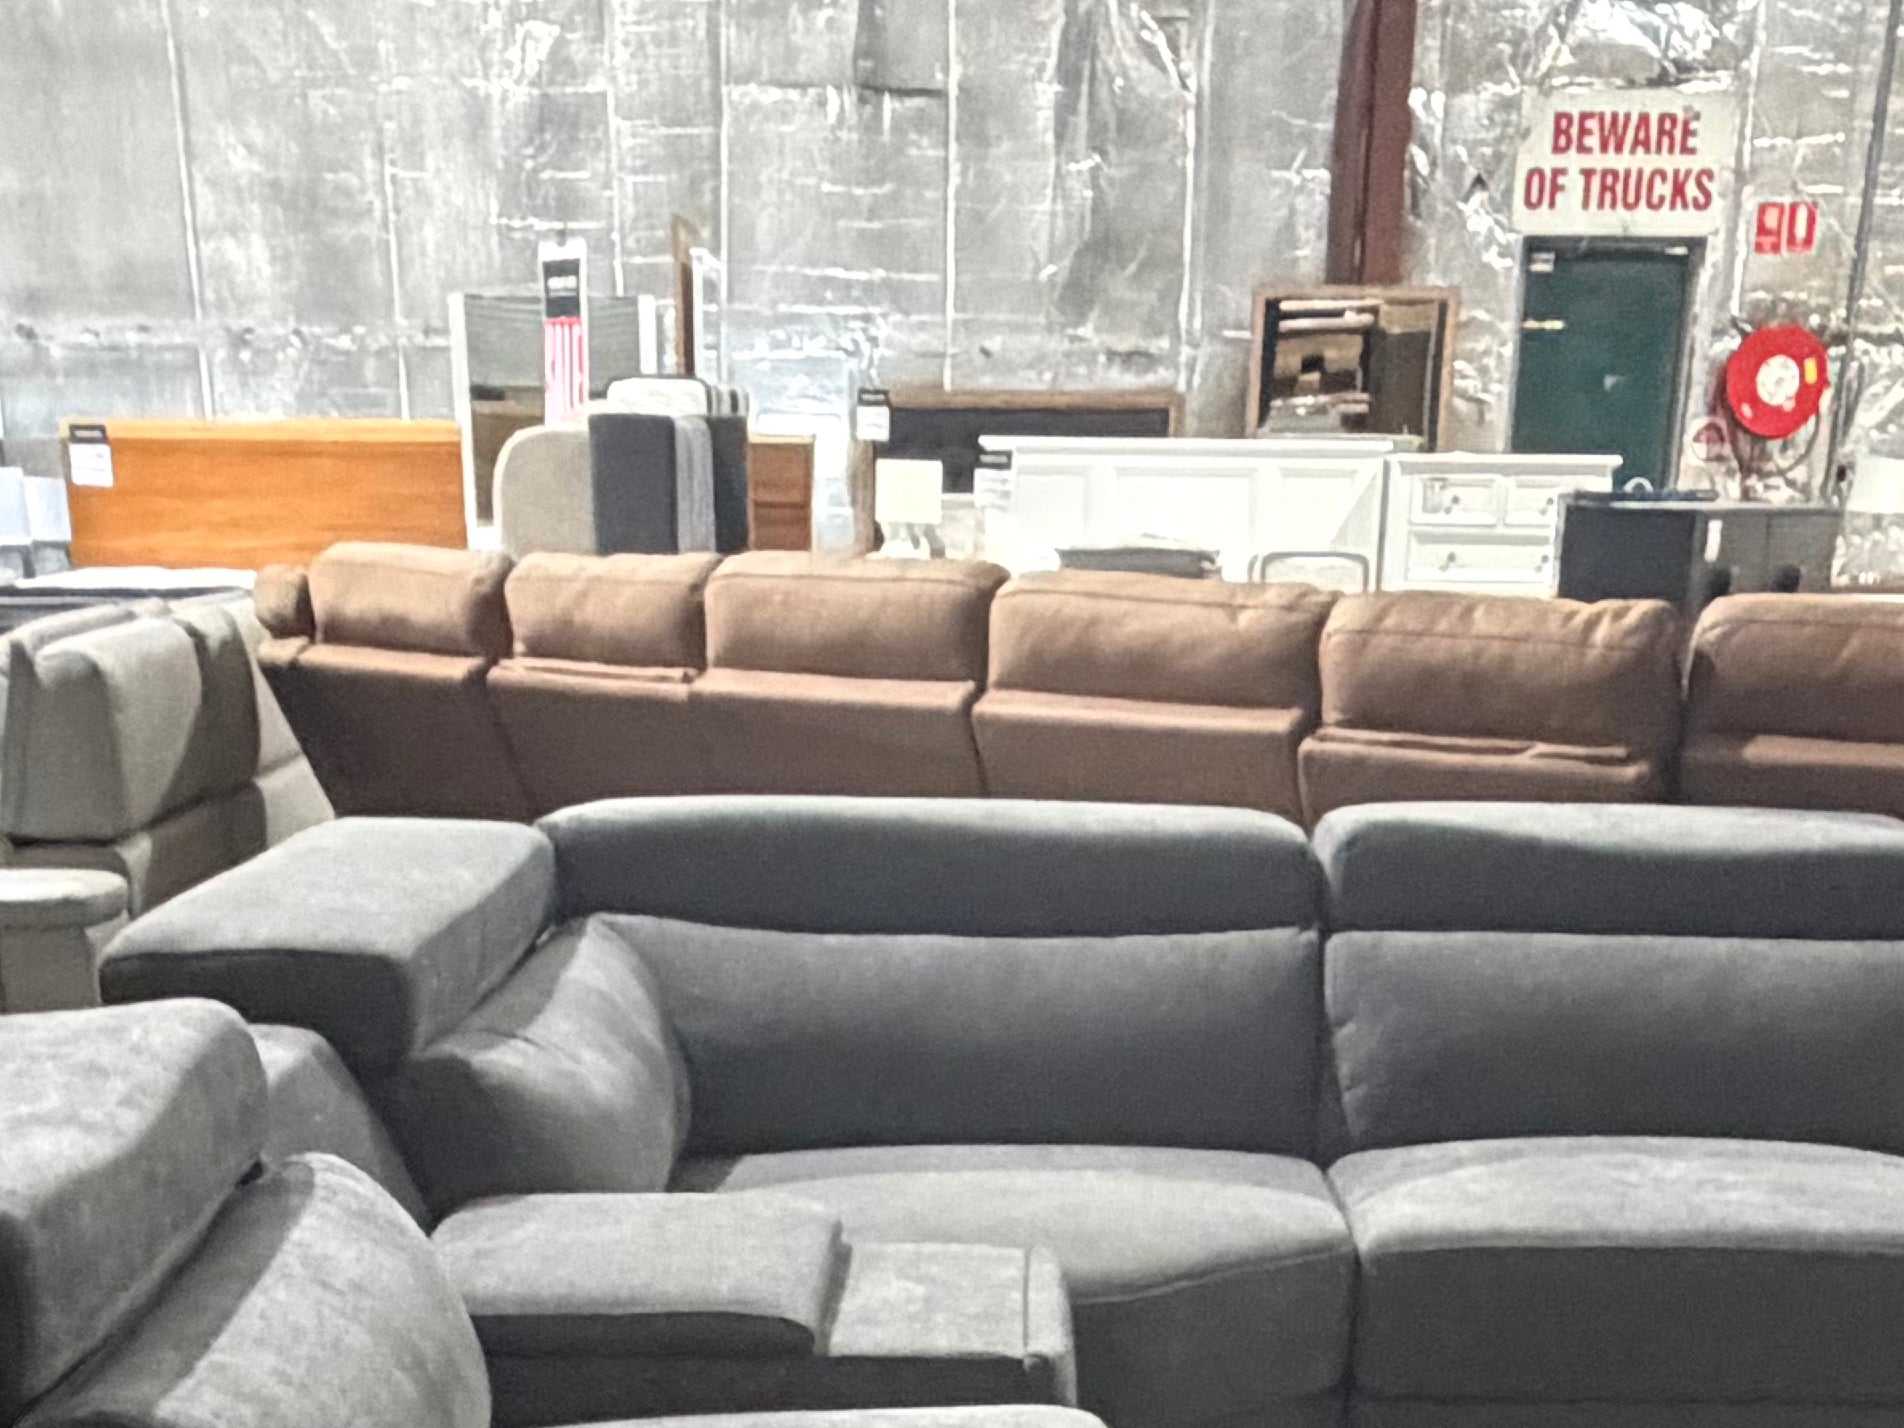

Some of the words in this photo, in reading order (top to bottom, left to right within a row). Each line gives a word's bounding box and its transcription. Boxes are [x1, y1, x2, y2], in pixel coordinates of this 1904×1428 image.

[1552, 111, 1701, 155] BEWARE
[1524, 167, 1569, 210] OF
[1579, 167, 1715, 211] TRUCKS
